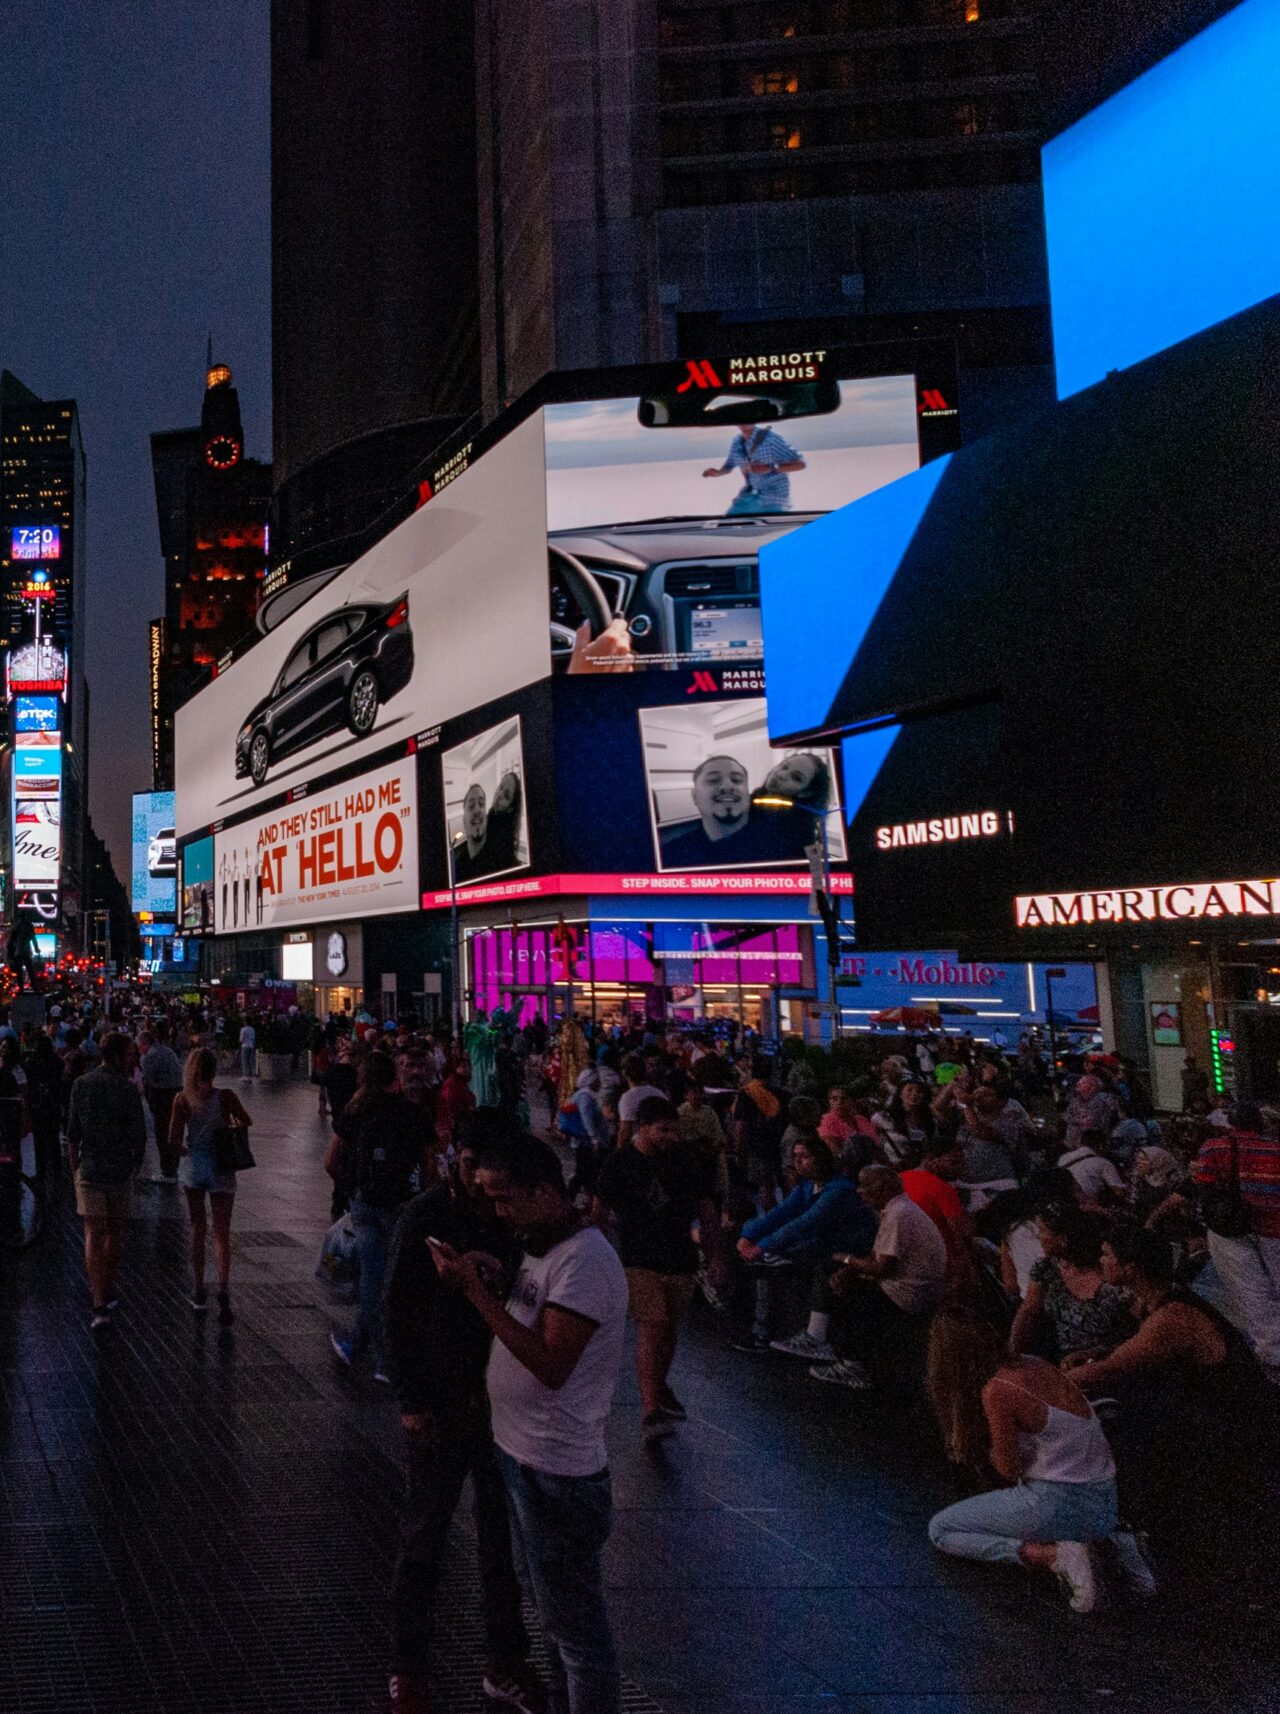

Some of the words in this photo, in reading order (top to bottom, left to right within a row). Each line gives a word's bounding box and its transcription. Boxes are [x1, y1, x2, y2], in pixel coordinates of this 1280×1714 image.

[730, 351, 826, 369] MARRIOTT
[731, 366, 816, 384] MARQUIS
[434, 442, 473, 481] MARRIOTT
[434, 458, 468, 493] MARQUIS
[19, 529, 53, 543] 7:20
[27, 583, 51, 591] 2016
[10, 681, 63, 691] TOSHIBA
[27, 709, 54, 719] TDK
[258, 822, 279, 847] AND
[280, 812, 308, 841] THEY
[310, 801, 342, 831] STILL
[345, 789, 375, 820] HAD
[378, 778, 402, 808] ME
[877, 811, 998, 849] SAMSUNG
[261, 844, 287, 896] AT
[622, 878, 650, 888] STEP
[650, 878, 689, 888] INSIDE.
[690, 878, 720, 888] SNAP
[721, 878, 753, 888] YOUR
[754, 878, 797, 888] PHOTO.
[1023, 881, 1277, 926] AMERICAN
